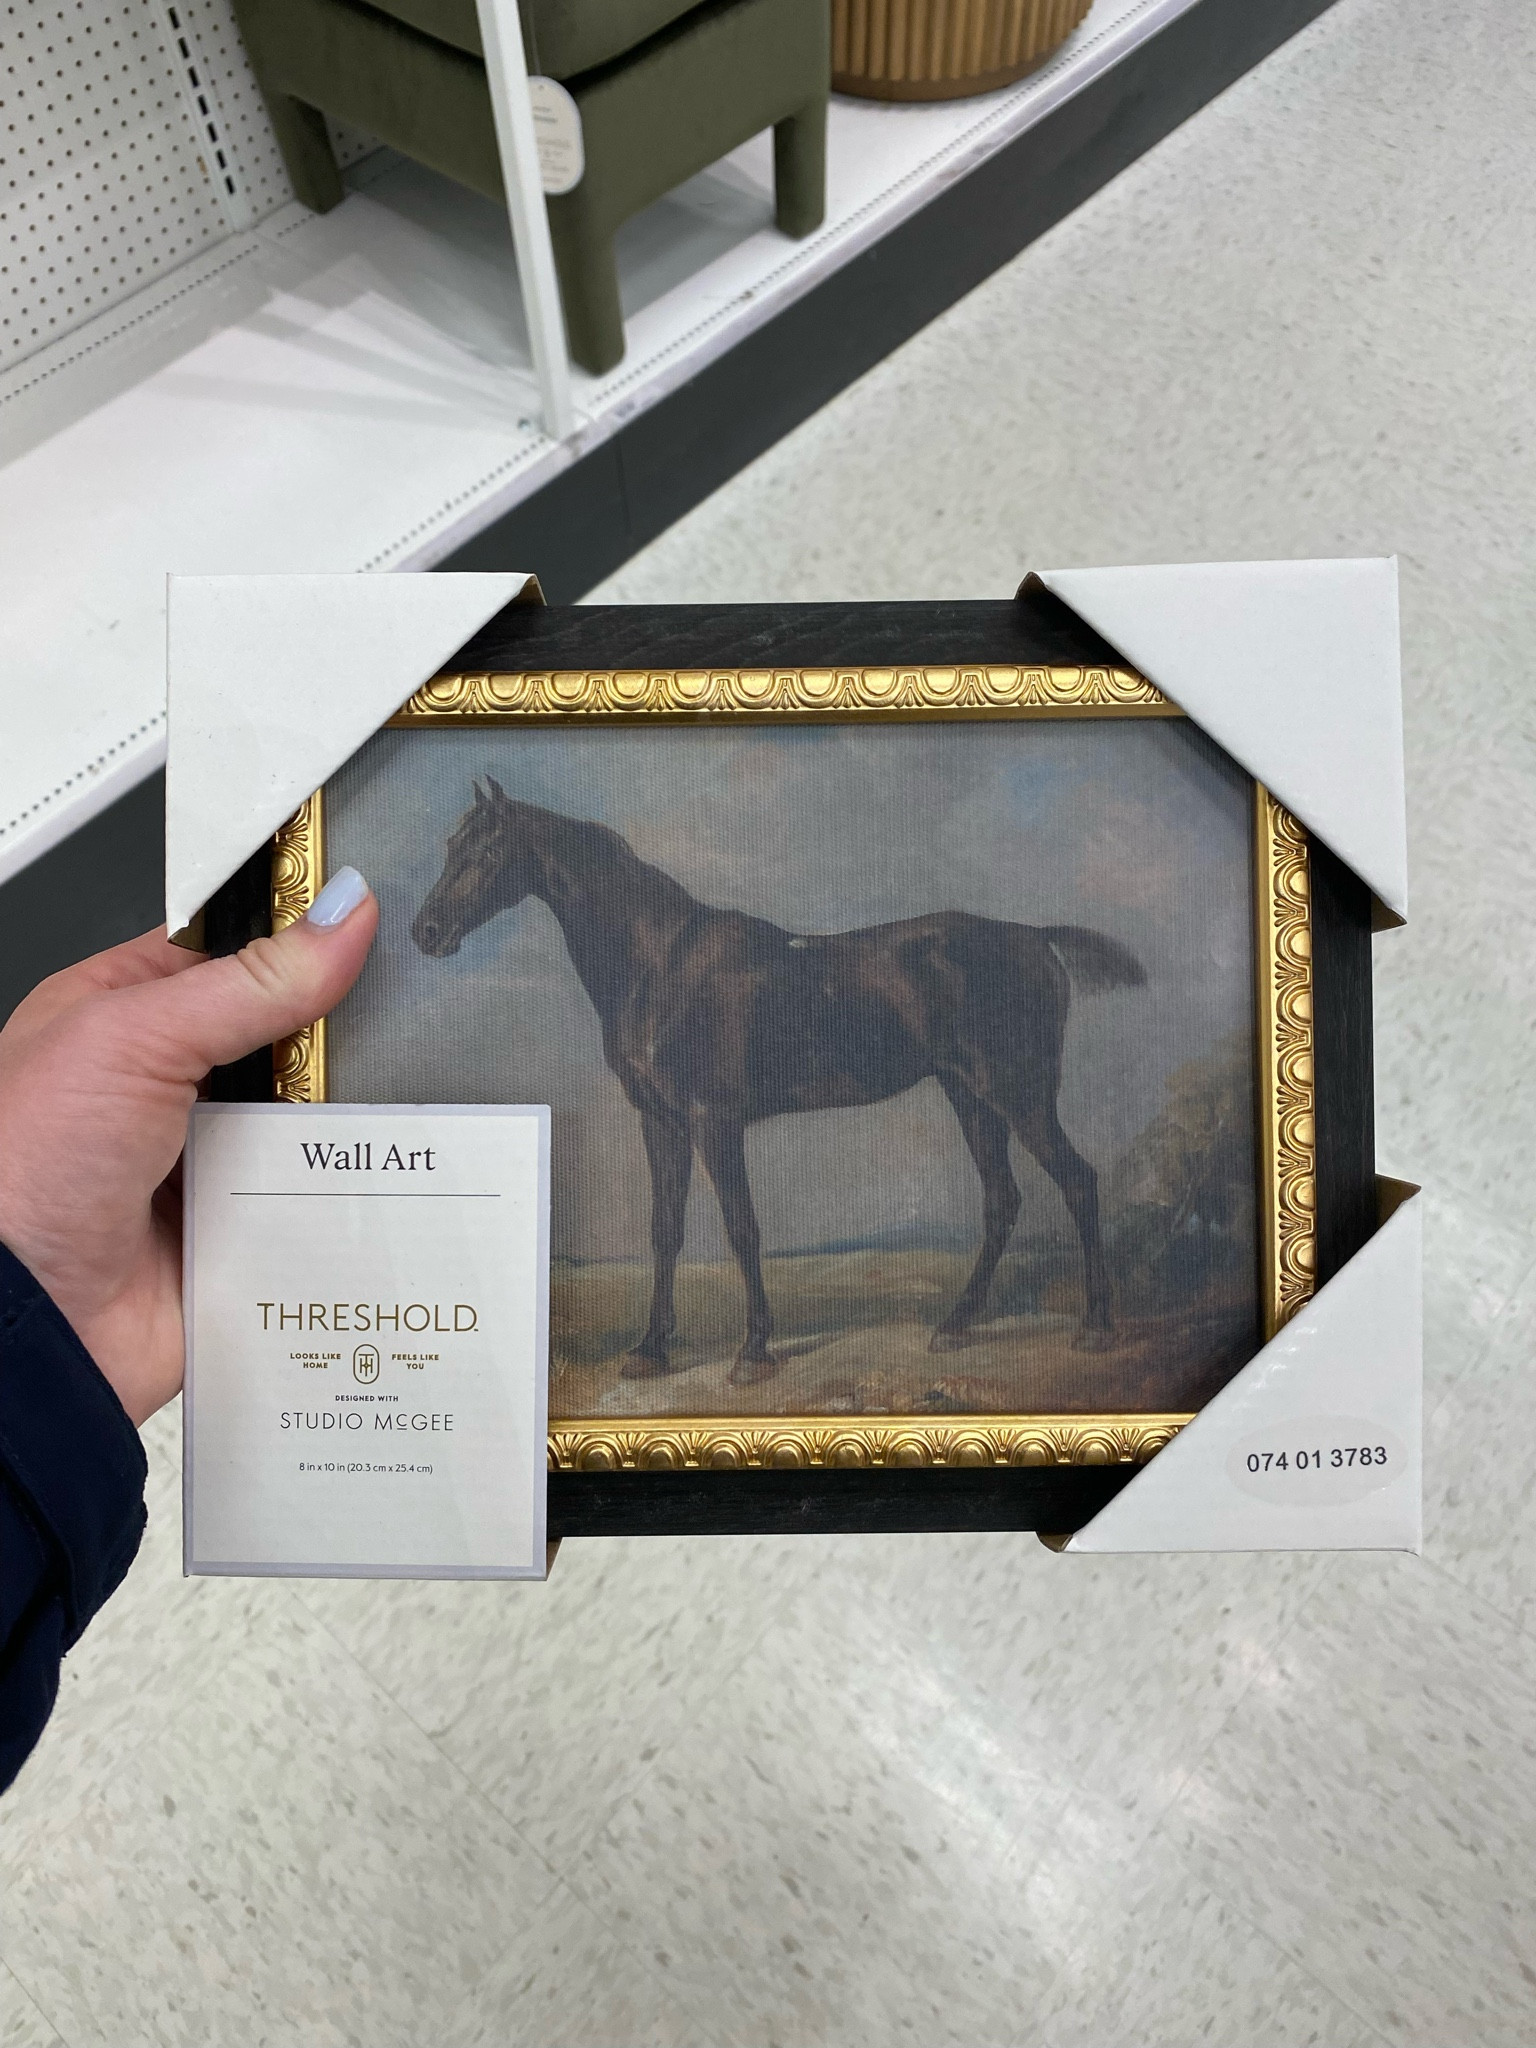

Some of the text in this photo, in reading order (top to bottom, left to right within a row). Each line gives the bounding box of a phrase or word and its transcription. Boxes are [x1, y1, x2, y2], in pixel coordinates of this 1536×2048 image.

[299, 1142, 437, 1171] Wall Art
[256, 1302, 479, 1333] THRESHOLD
[289, 1352, 342, 1360] LOOKS LIKE
[391, 1353, 440, 1361] FEELS LIKE
[302, 1361, 329, 1369] HOME
[406, 1362, 425, 1370] YOU
[335, 1394, 375, 1402] DESIGNED
[280, 1411, 363, 1430] STUDIO
[1246, 1446, 1388, 1473] 074 01 3783
[299, 1462, 434, 1475] 8 in x 10 in (20.3 cm x 25.4 cm)
